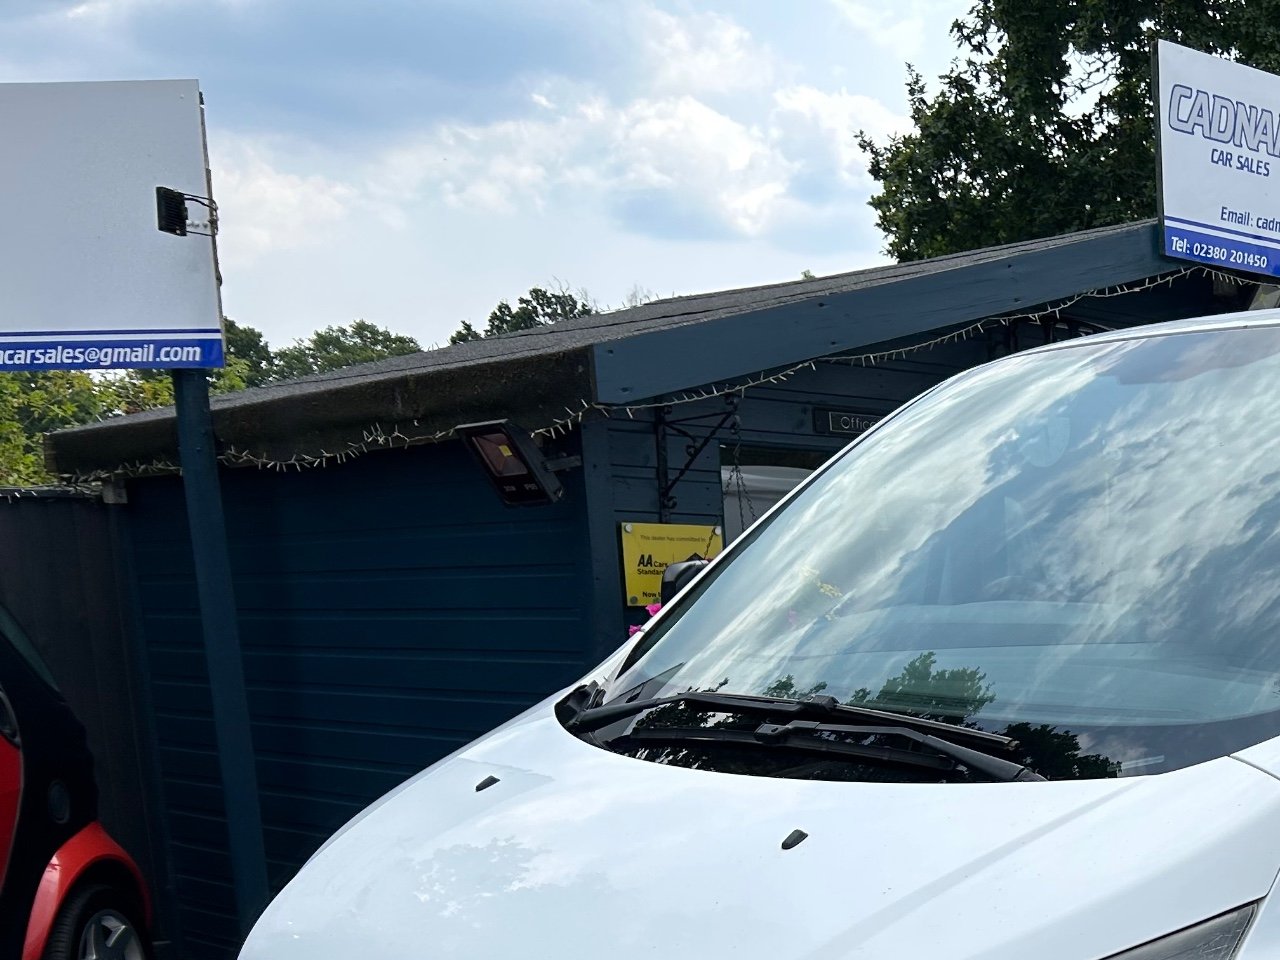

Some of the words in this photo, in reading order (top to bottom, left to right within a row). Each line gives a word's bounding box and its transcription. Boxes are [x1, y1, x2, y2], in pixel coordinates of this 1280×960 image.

[1210, 148, 1233, 170] CAR
[1236, 155, 1270, 177] SALES
[1220, 206, 1254, 227] Email:
[1171, 236, 1191, 254] Tel:
[1193, 242, 1227, 261] 02380
[1230, 250, 1268, 268] 201450
[638, 554, 653, 567] AA
